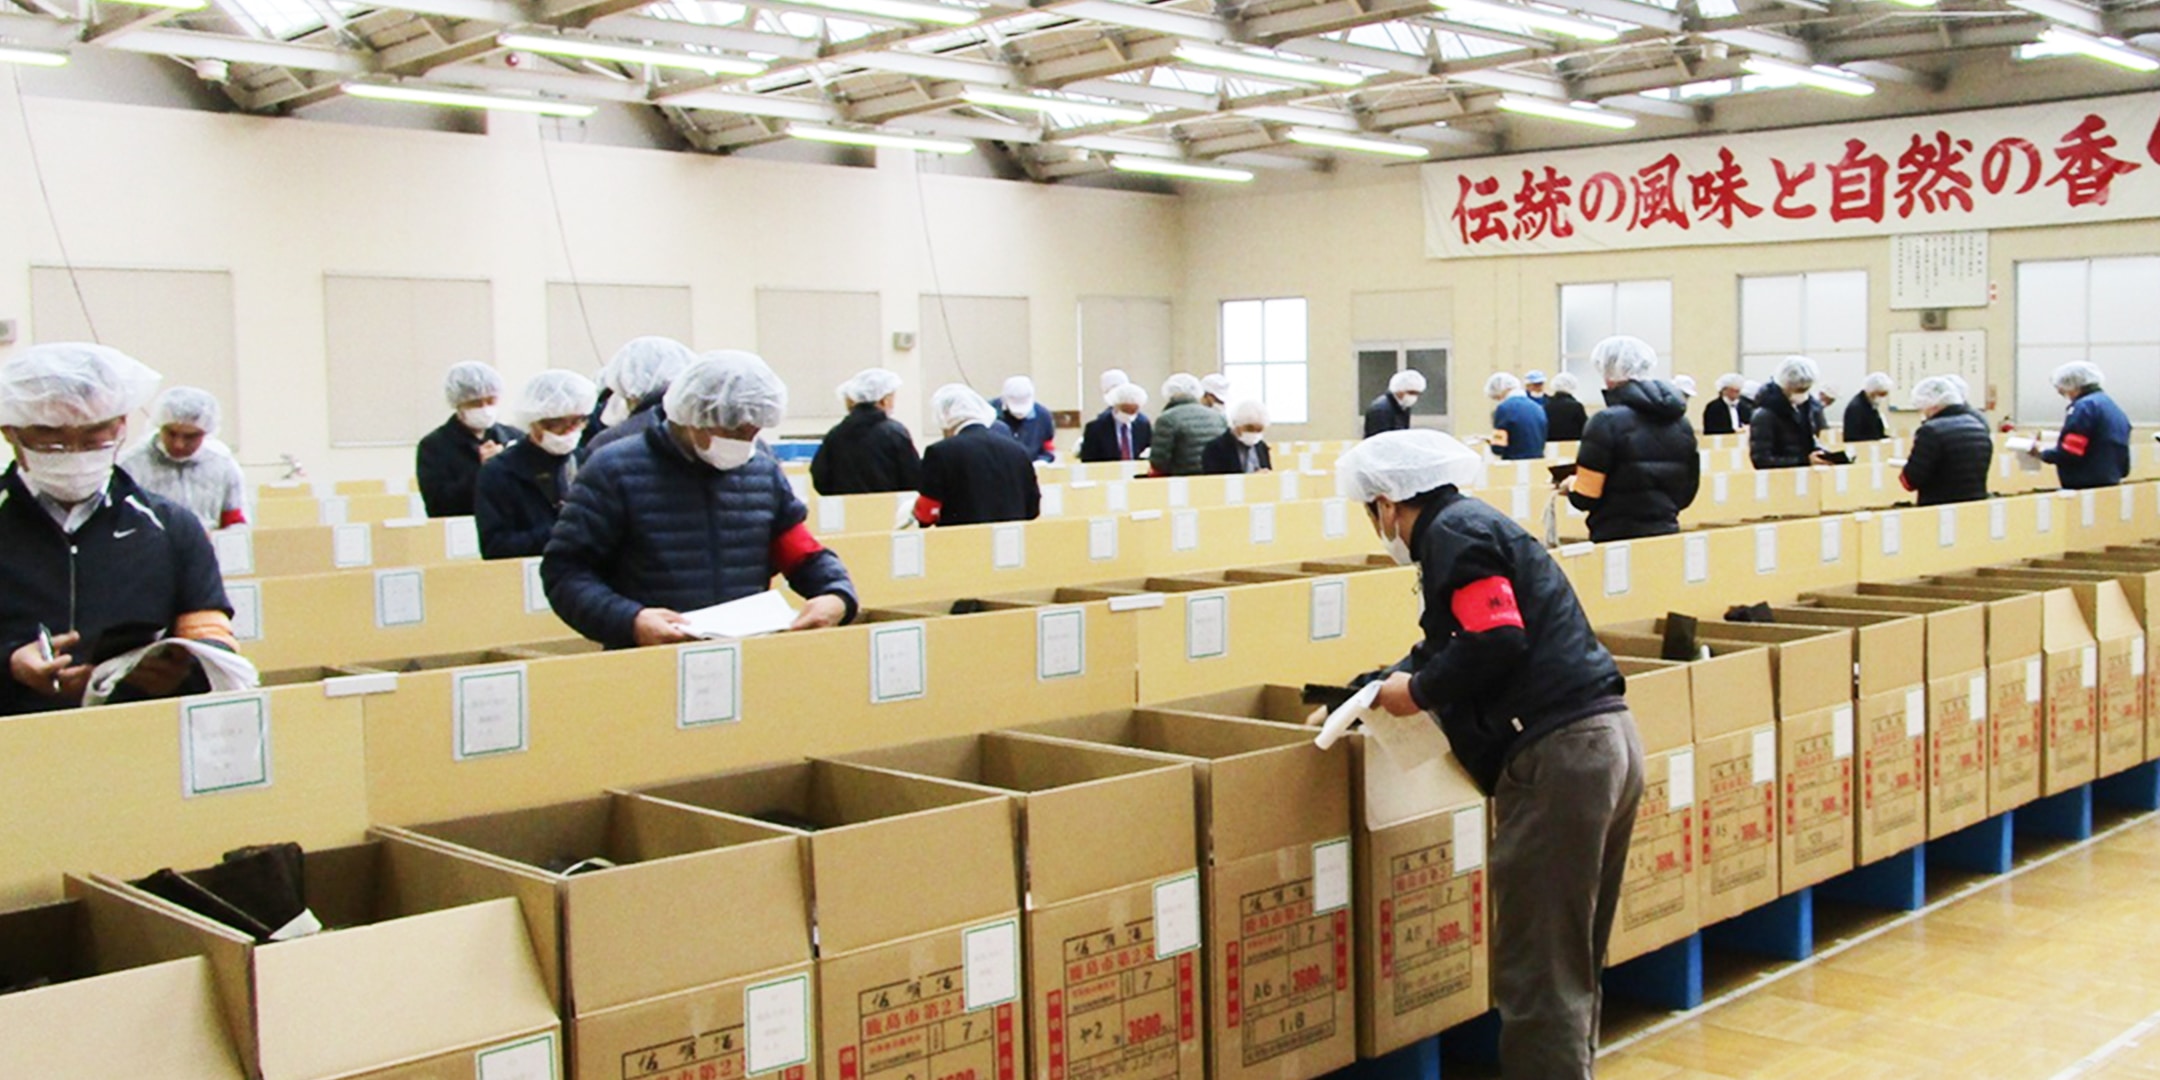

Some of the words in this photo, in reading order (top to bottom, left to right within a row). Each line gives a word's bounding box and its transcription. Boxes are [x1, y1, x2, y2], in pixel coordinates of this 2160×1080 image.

[1452, 113, 2160, 244] 伝統の風味と自然の香
